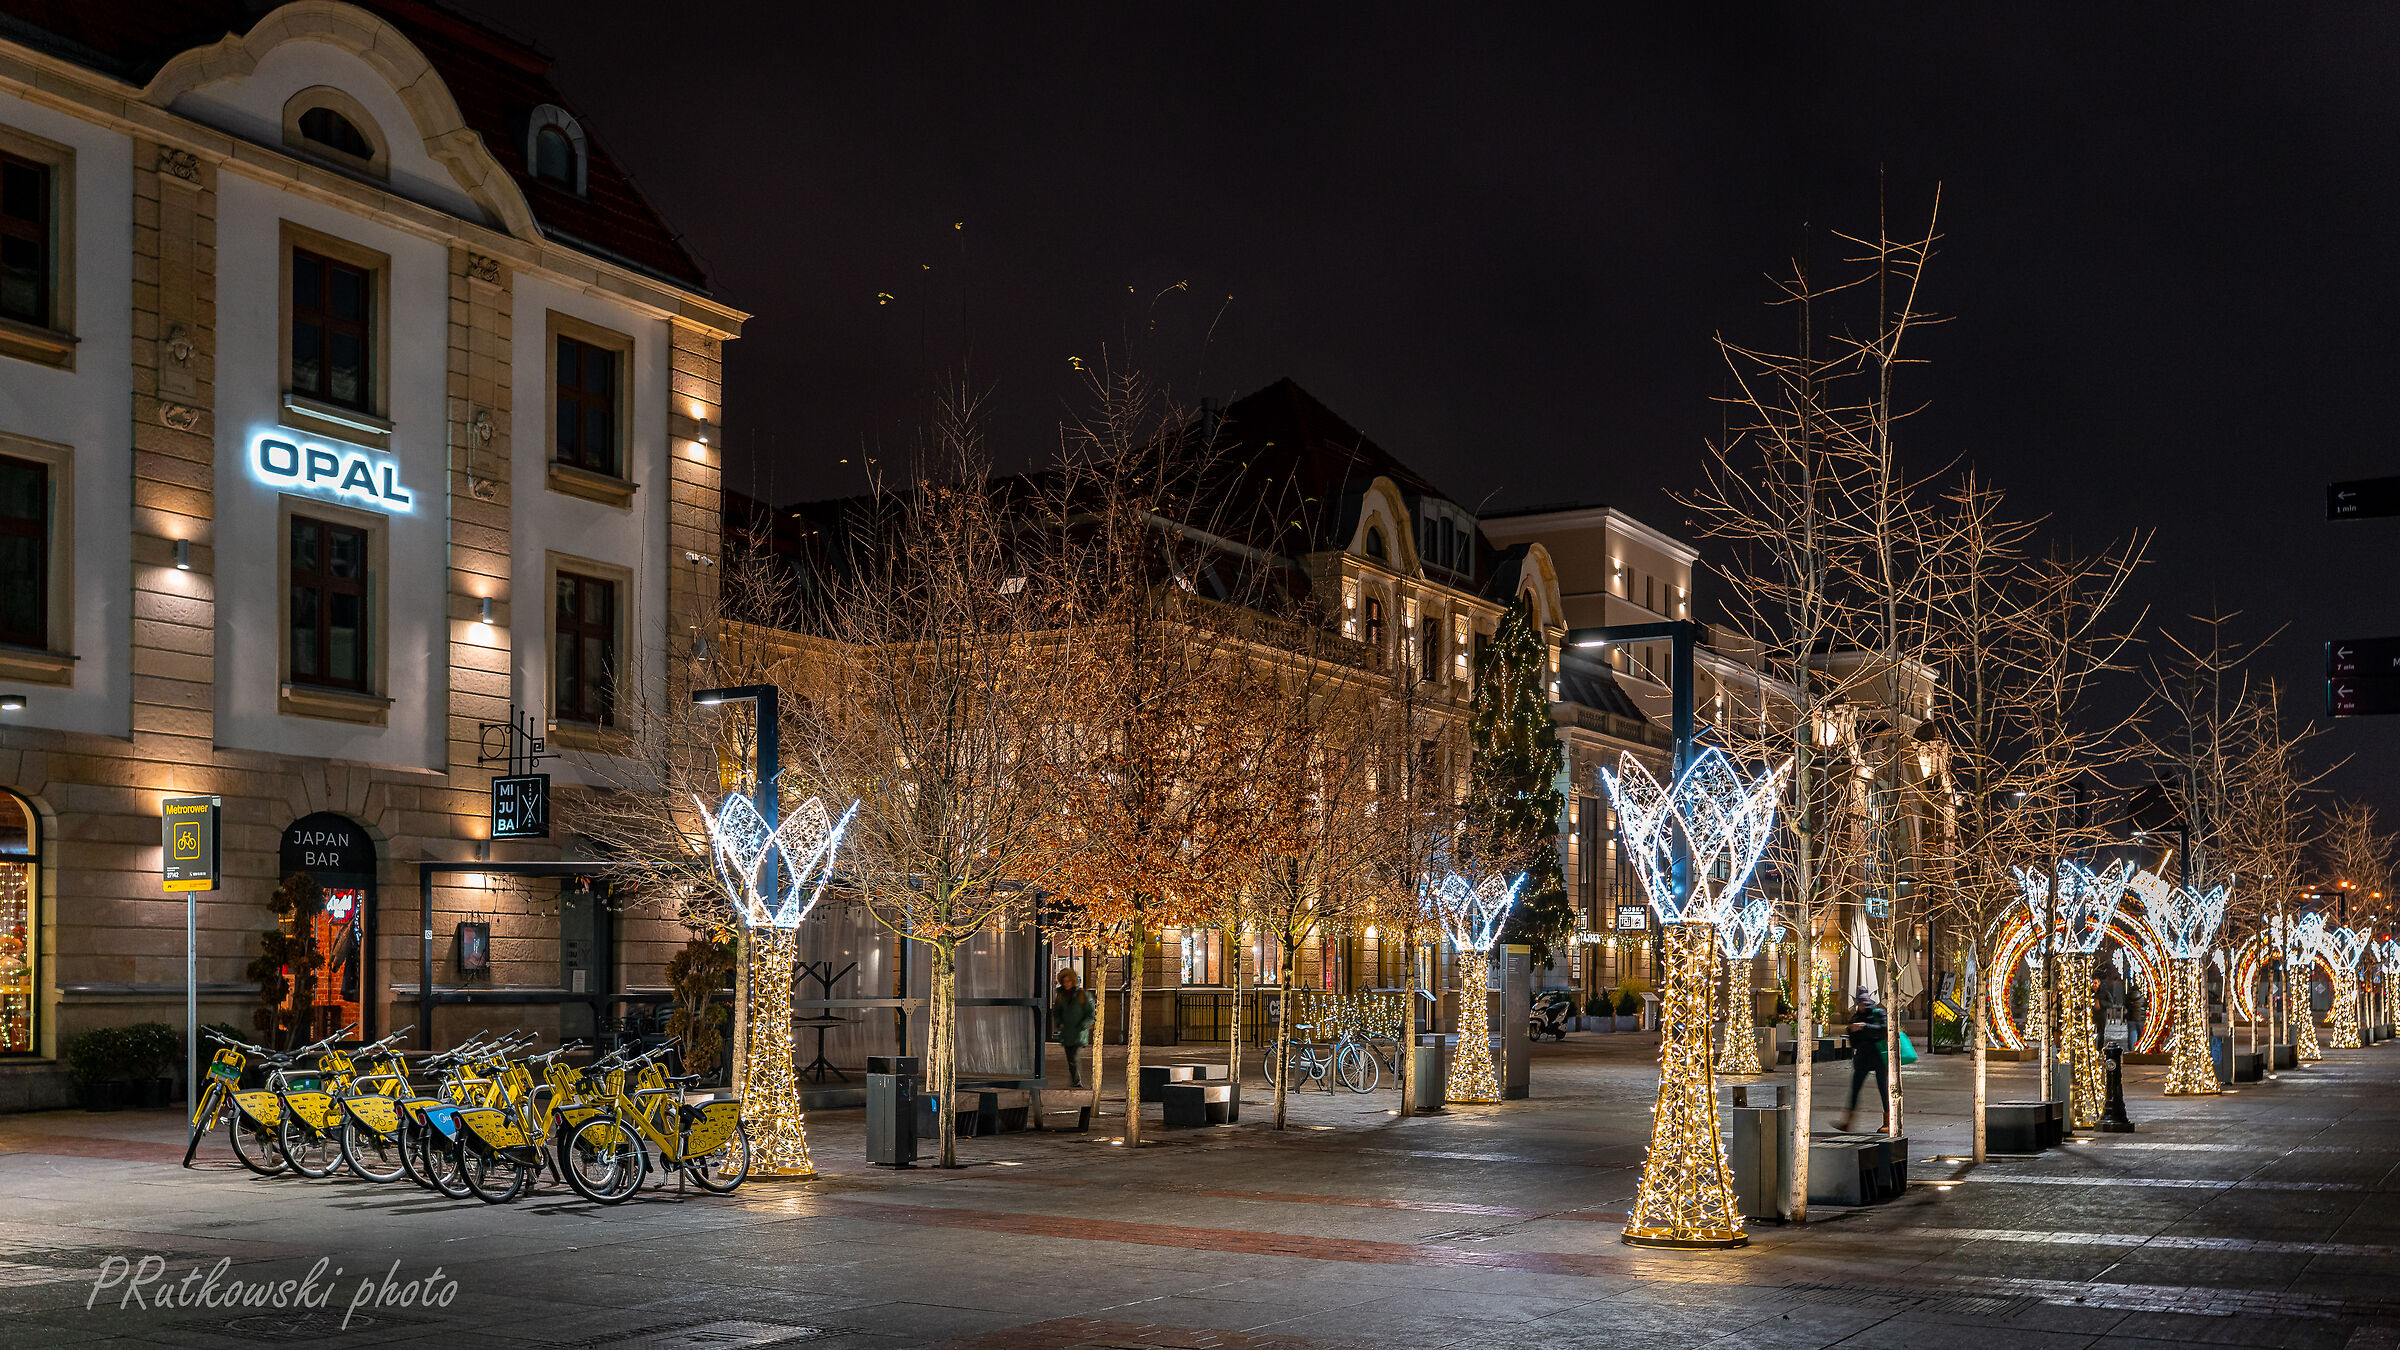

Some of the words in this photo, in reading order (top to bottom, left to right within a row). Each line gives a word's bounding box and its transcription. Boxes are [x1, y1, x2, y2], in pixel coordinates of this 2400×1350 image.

[259, 438, 410, 504] OPAL
[500, 783, 513, 796] MI
[165, 804, 209, 815] Metrorower
[498, 801, 514, 814] JU
[497, 818, 515, 831] BA
[293, 830, 349, 847] JAPAN
[305, 851, 340, 867] BAR
